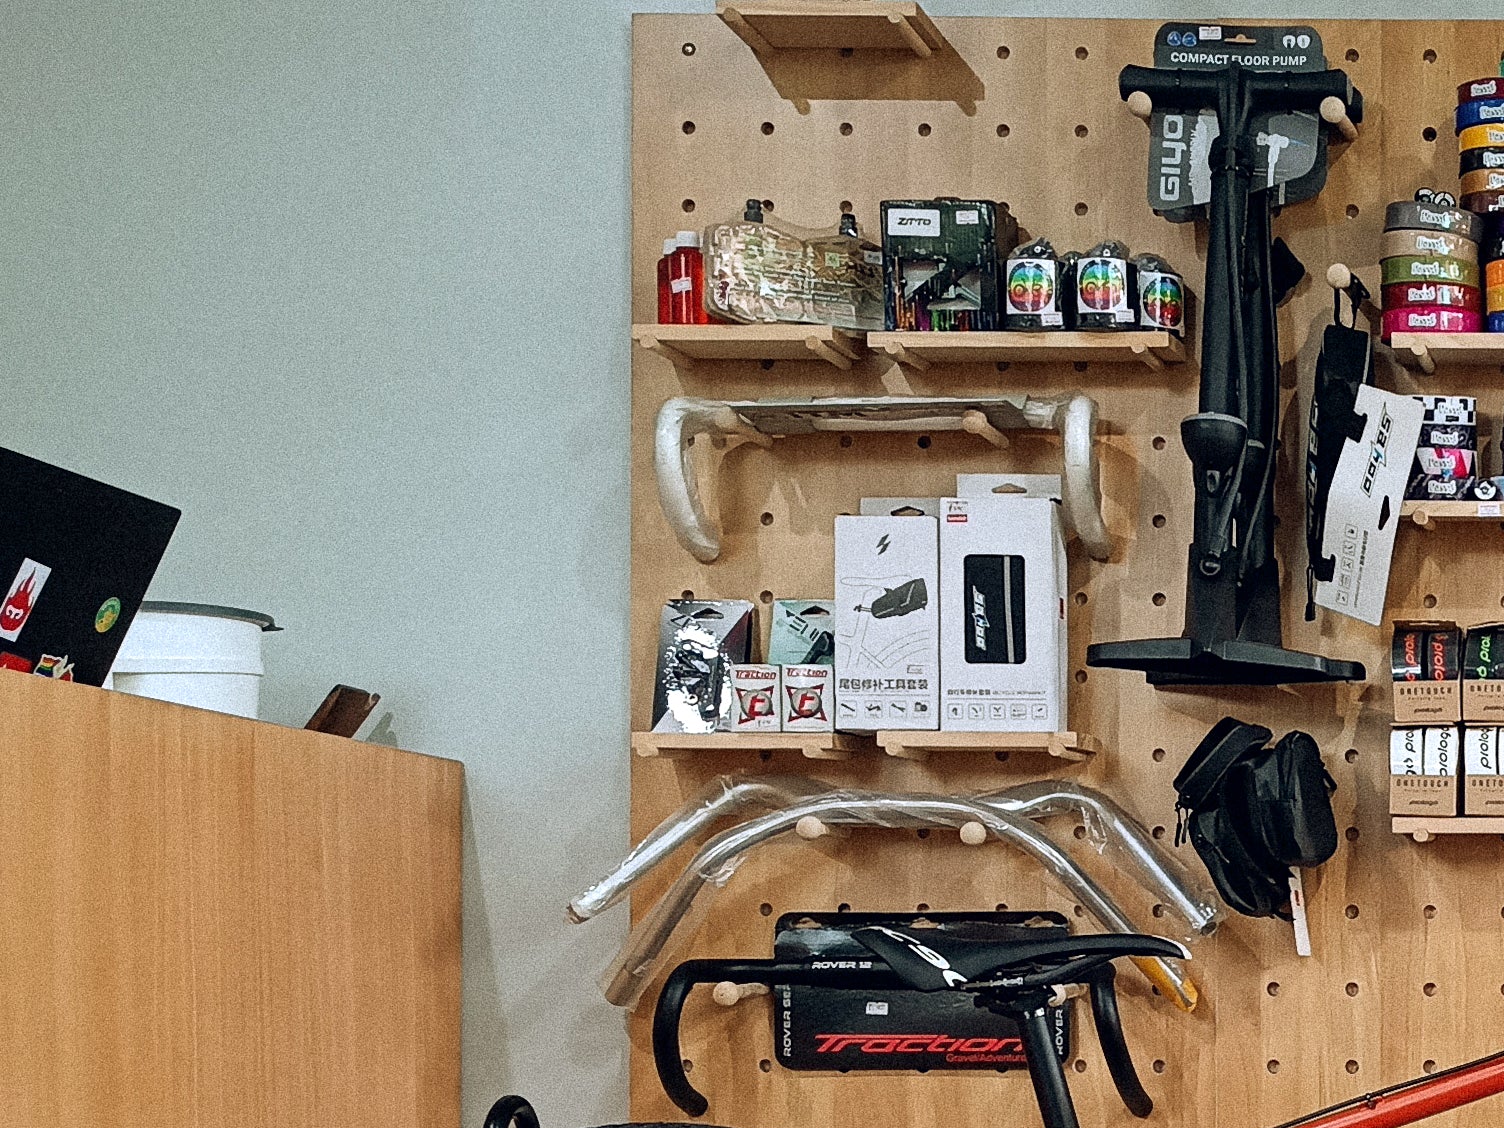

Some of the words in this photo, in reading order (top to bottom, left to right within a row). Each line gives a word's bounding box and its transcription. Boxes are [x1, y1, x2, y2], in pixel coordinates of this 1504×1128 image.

[1170, 52, 1229, 65] COMPACT
[1272, 56, 1308, 66] PUMP
[1159, 114, 1187, 201] GIYO
[735, 668, 778, 680] Traction
[786, 666, 829, 679] Traction
[838, 677, 929, 691] 尾包修补工具套装
[1399, 686, 1452, 695] ONETOUCH
[1396, 778, 1449, 788] ONETOUCH
[811, 960, 856, 969] ROVER
[782, 1010, 792, 1057] ROVER
[813, 1032, 1024, 1055] Traction
